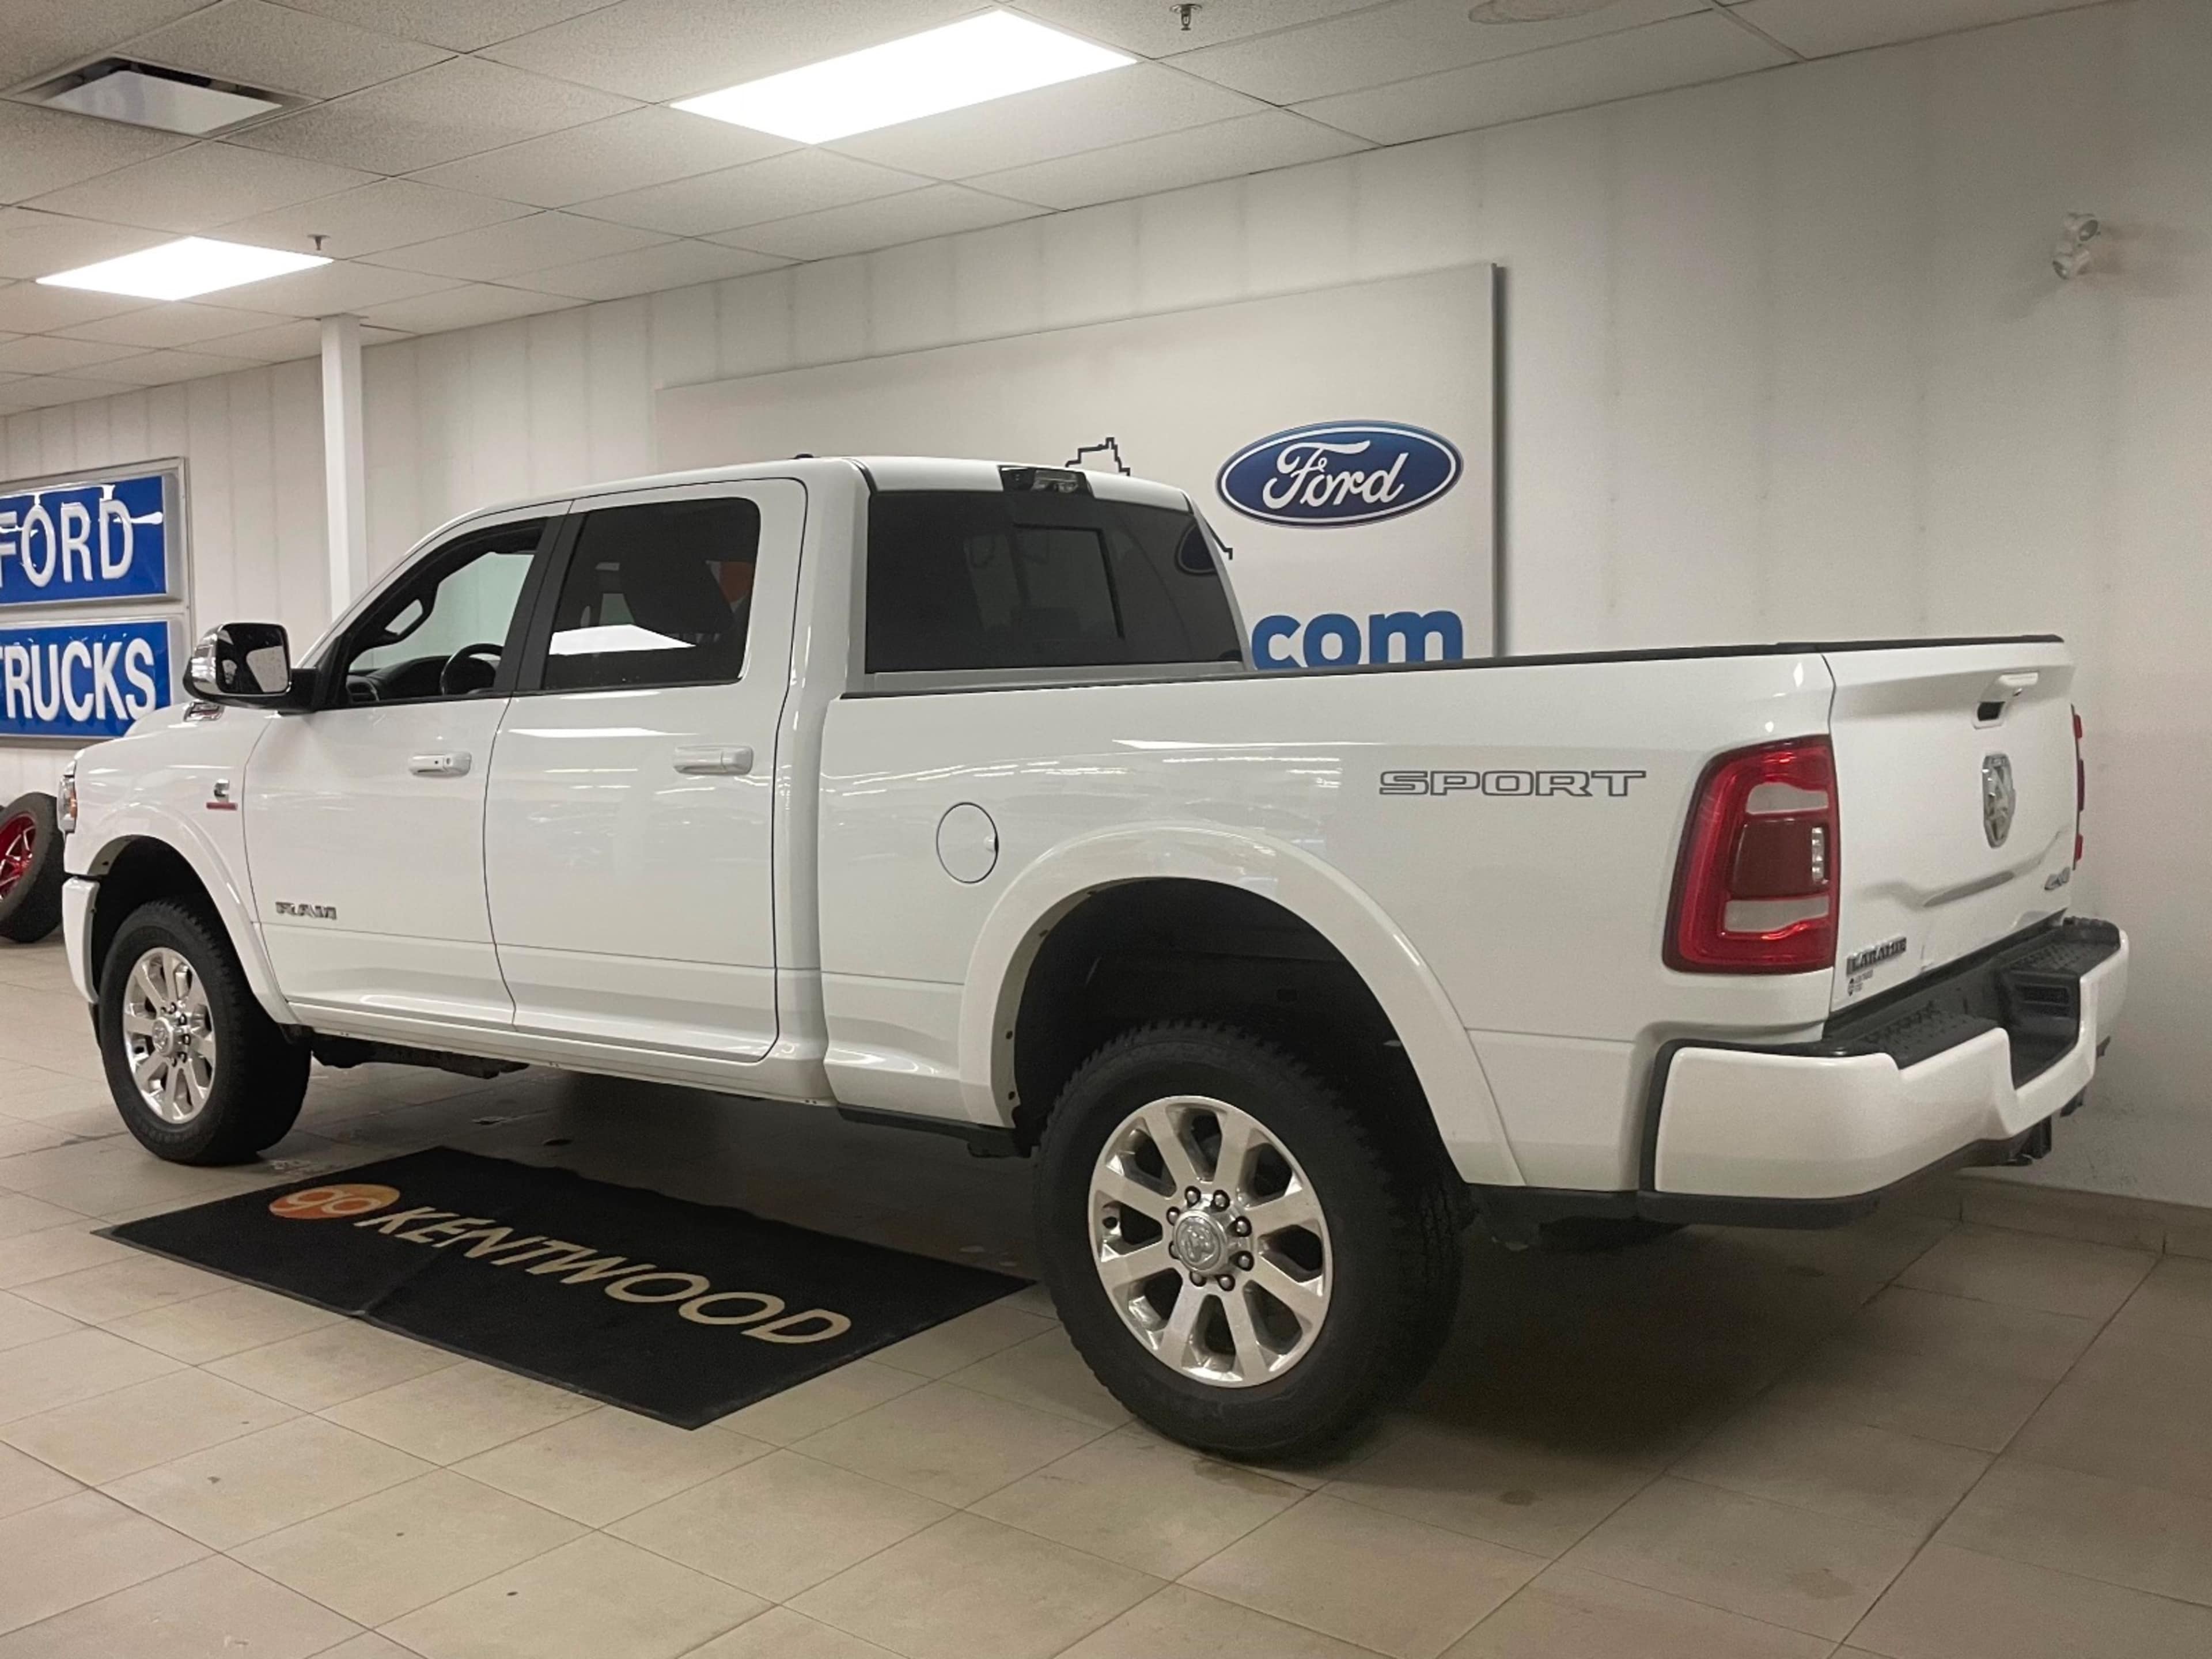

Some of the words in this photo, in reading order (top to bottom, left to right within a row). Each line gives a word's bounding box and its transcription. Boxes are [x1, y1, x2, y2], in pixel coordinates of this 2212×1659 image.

[1262, 440, 1410, 509] Ford
[0, 638, 157, 722] RUCKS
[1380, 770, 1647, 797] SPORT
[275, 902, 338, 921] RAM
[353, 1206, 852, 1344] KENTWOOD
